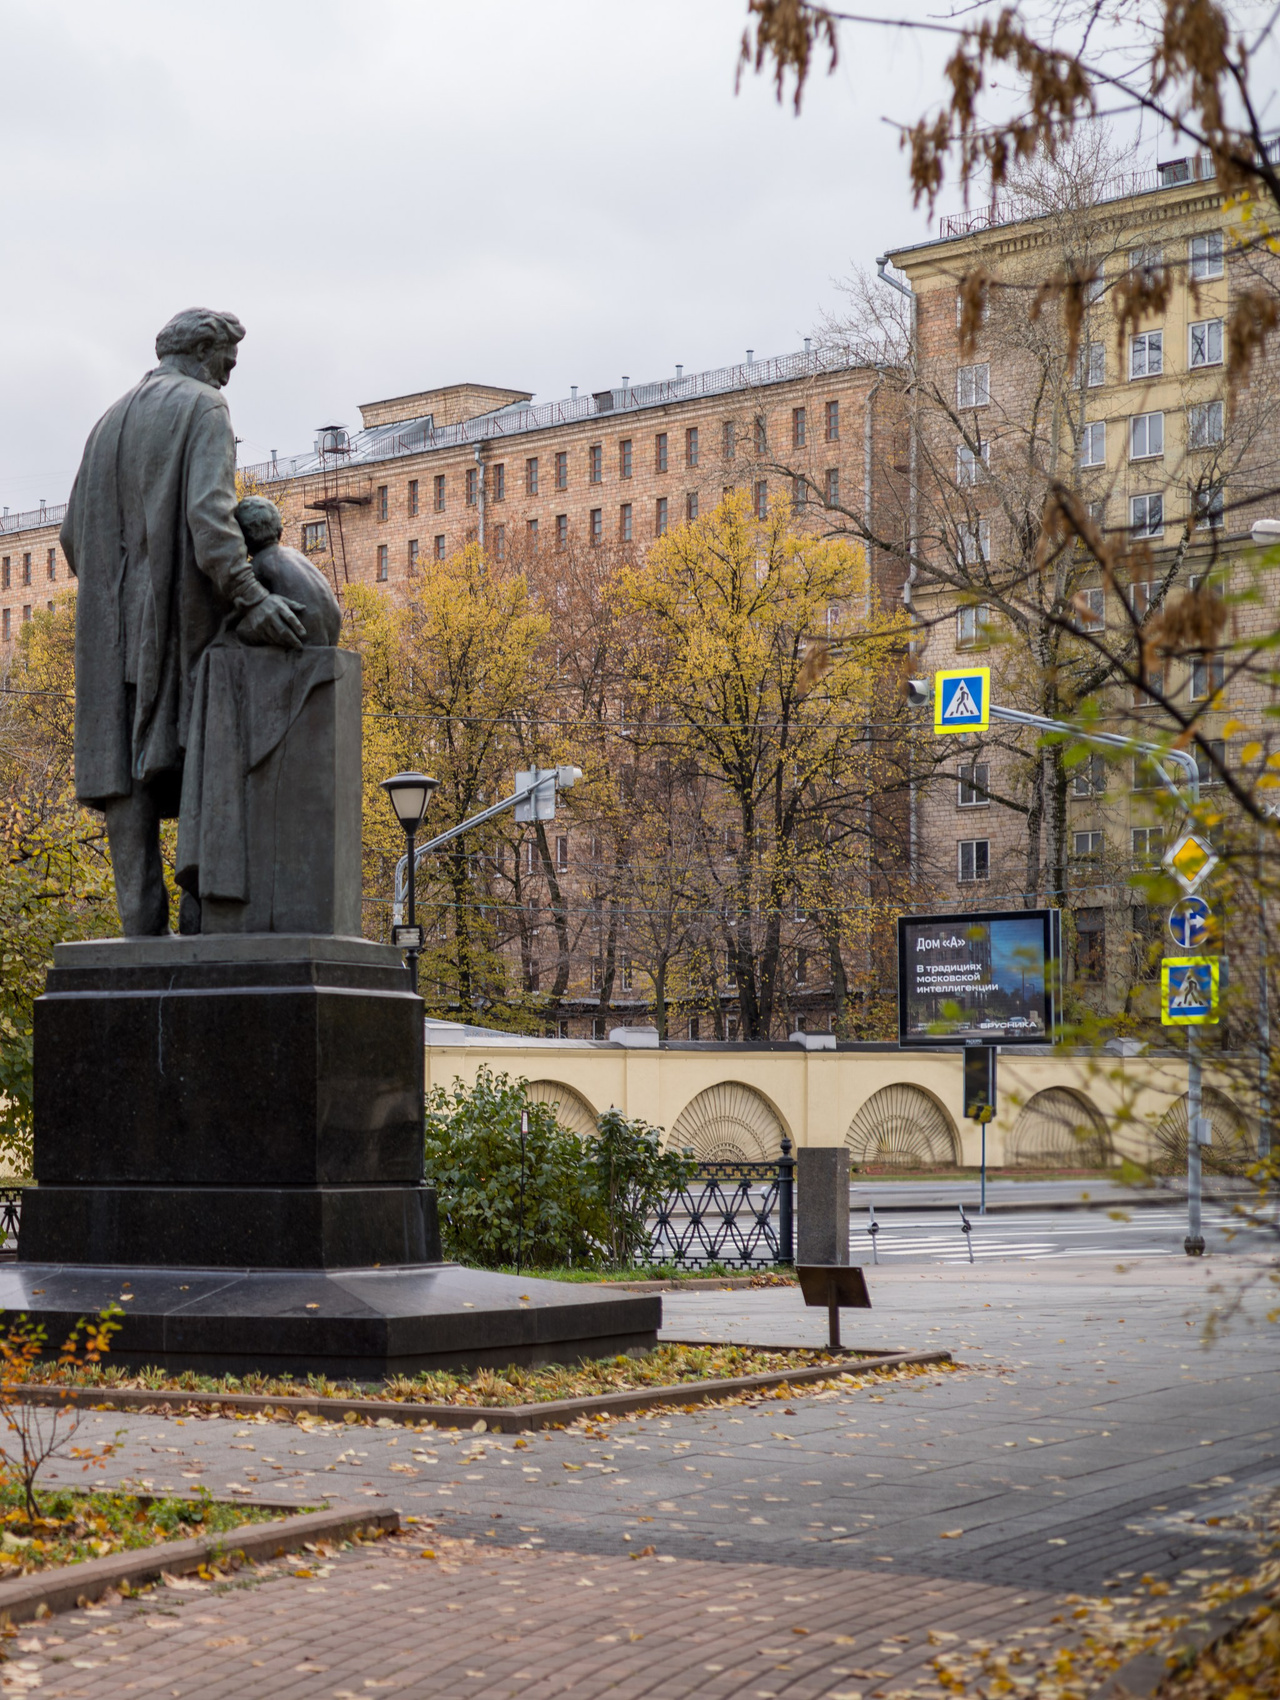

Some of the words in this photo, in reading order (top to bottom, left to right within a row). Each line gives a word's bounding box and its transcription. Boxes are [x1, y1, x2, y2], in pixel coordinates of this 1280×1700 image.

[916, 937, 940, 952] Дом
[916, 965, 925, 973] В
[926, 963, 982, 974] традициях
[916, 973, 980, 983] московской
[916, 984, 999, 993] интеллигенции
[980, 1021, 1037, 1029] БРУСНИКА
